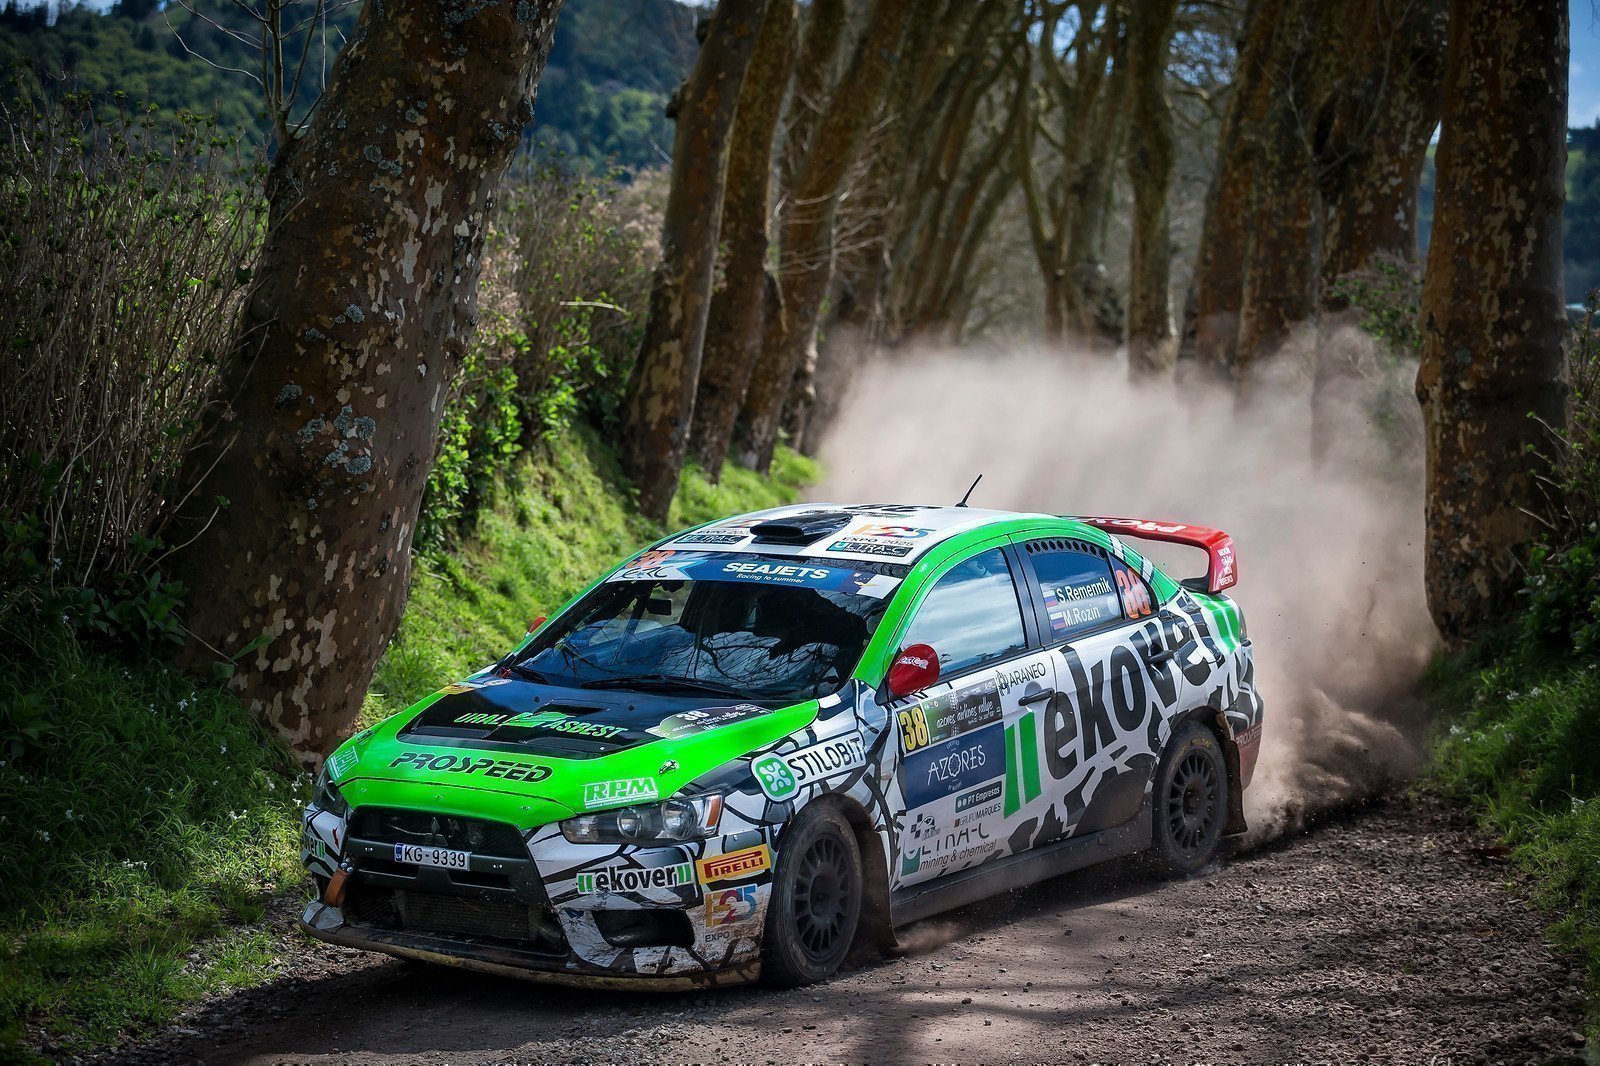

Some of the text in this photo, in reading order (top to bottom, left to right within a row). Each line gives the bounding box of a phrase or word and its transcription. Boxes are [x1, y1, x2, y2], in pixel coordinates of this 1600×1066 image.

[834, 542, 906, 553] ULTRA-C
[722, 562, 830, 579] SEAJETS
[736, 573, 761, 582] Racing
[1056, 577, 1112, 604] S.Remennik
[1116, 568, 1151, 619] 38
[1062, 604, 1101, 627] M.Rozin
[1009, 662, 1046, 688] ARANEO
[676, 710, 710, 721] 38
[901, 707, 929, 751] 38
[388, 752, 553, 783] PROSPEED
[787, 737, 863, 781] STILOBIT
[927, 744, 986, 785] AZORES
[584, 777, 659, 803] RPM
[967, 786, 1000, 806] PT Empresas
[703, 850, 764, 879] PIRELLI
[919, 838, 998, 872] mining & chemical
[595, 865, 678, 892] ekover
[705, 931, 730, 942] EXPO
